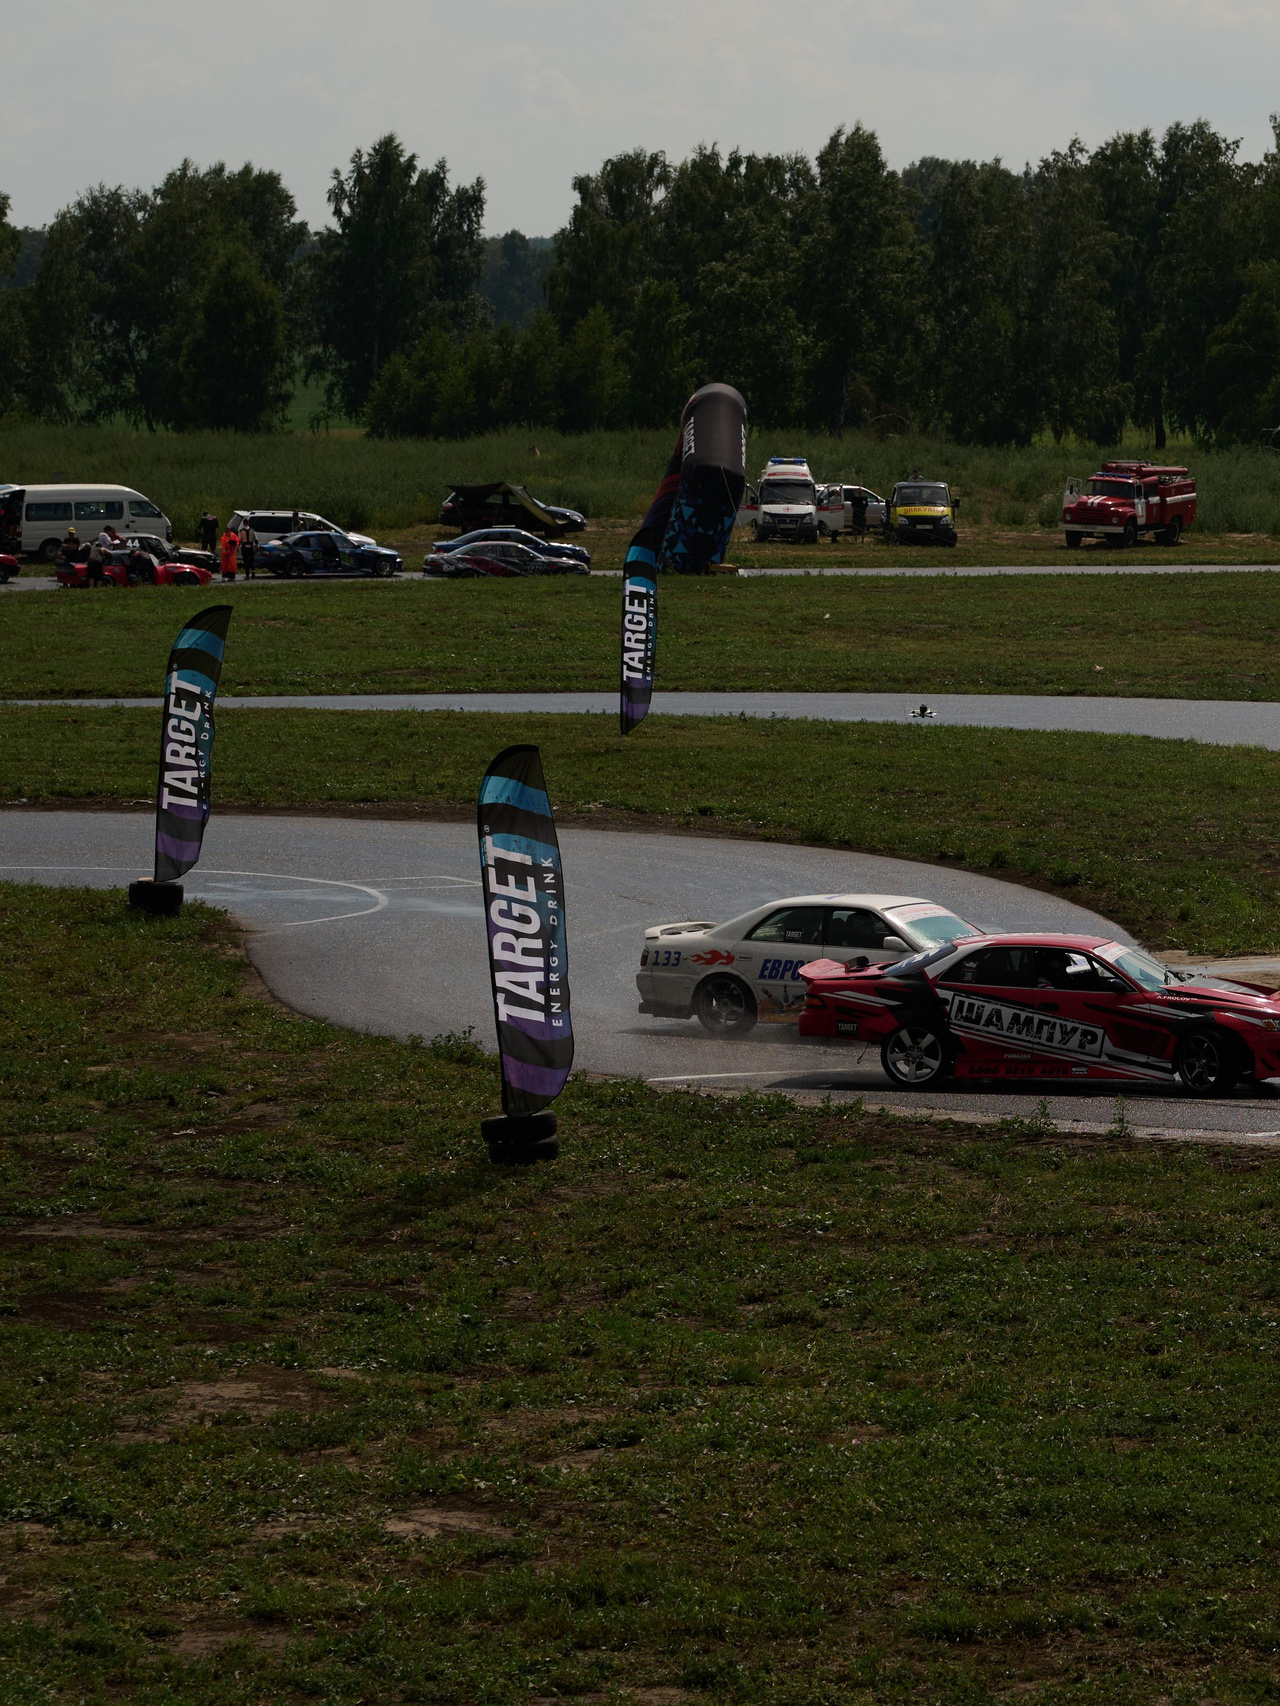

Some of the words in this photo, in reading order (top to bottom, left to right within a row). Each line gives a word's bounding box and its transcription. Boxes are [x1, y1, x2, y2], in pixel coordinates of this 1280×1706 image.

[126, 538, 140, 548] 44
[623, 578, 648, 681] TARGET
[161, 671, 202, 810] TARGET
[200, 690, 213, 740] DRINK
[541, 857, 558, 926] DRINK
[485, 835, 546, 1023] TARGET
[548, 941, 563, 1027] ENERGY
[652, 950, 682, 967] 133
[759, 959, 805, 980] ЕВРО
[838, 1023, 858, 1032] TARGET
[955, 999, 1100, 1050] ШАМПУР
